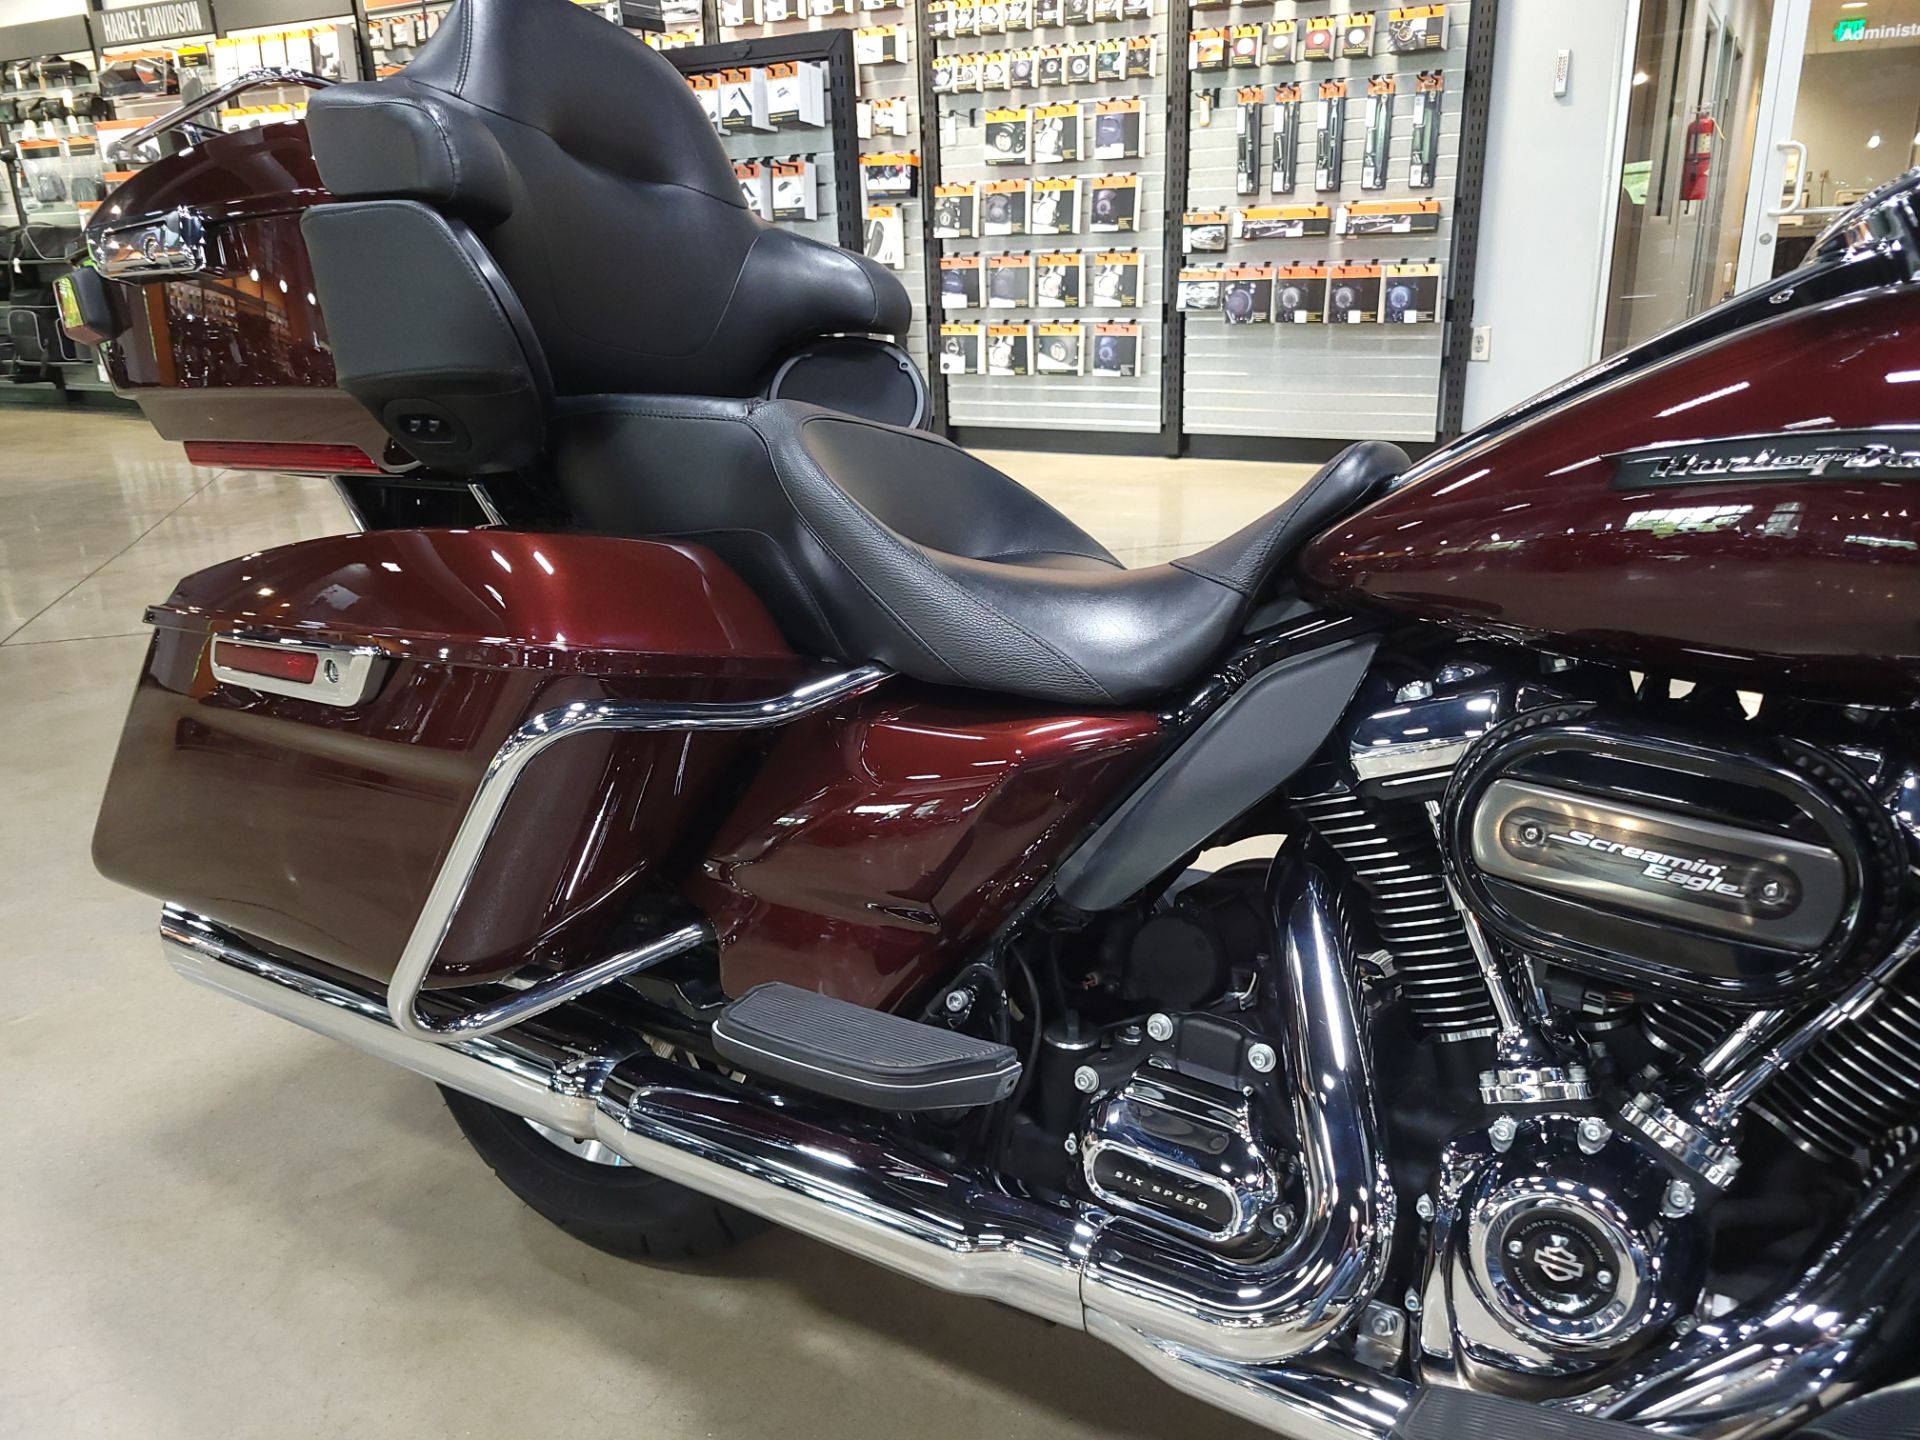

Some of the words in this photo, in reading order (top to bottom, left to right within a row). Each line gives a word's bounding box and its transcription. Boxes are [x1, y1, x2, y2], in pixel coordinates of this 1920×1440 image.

[101, 1, 202, 42] HARLEY-DAVIDSON
[1642, 863, 1746, 898] Eagle
[1114, 1170, 1144, 1187] SIX
[1151, 1185, 1208, 1209] SPEED
[1519, 1219, 1605, 1262] HARLEY-DAVIDSON
